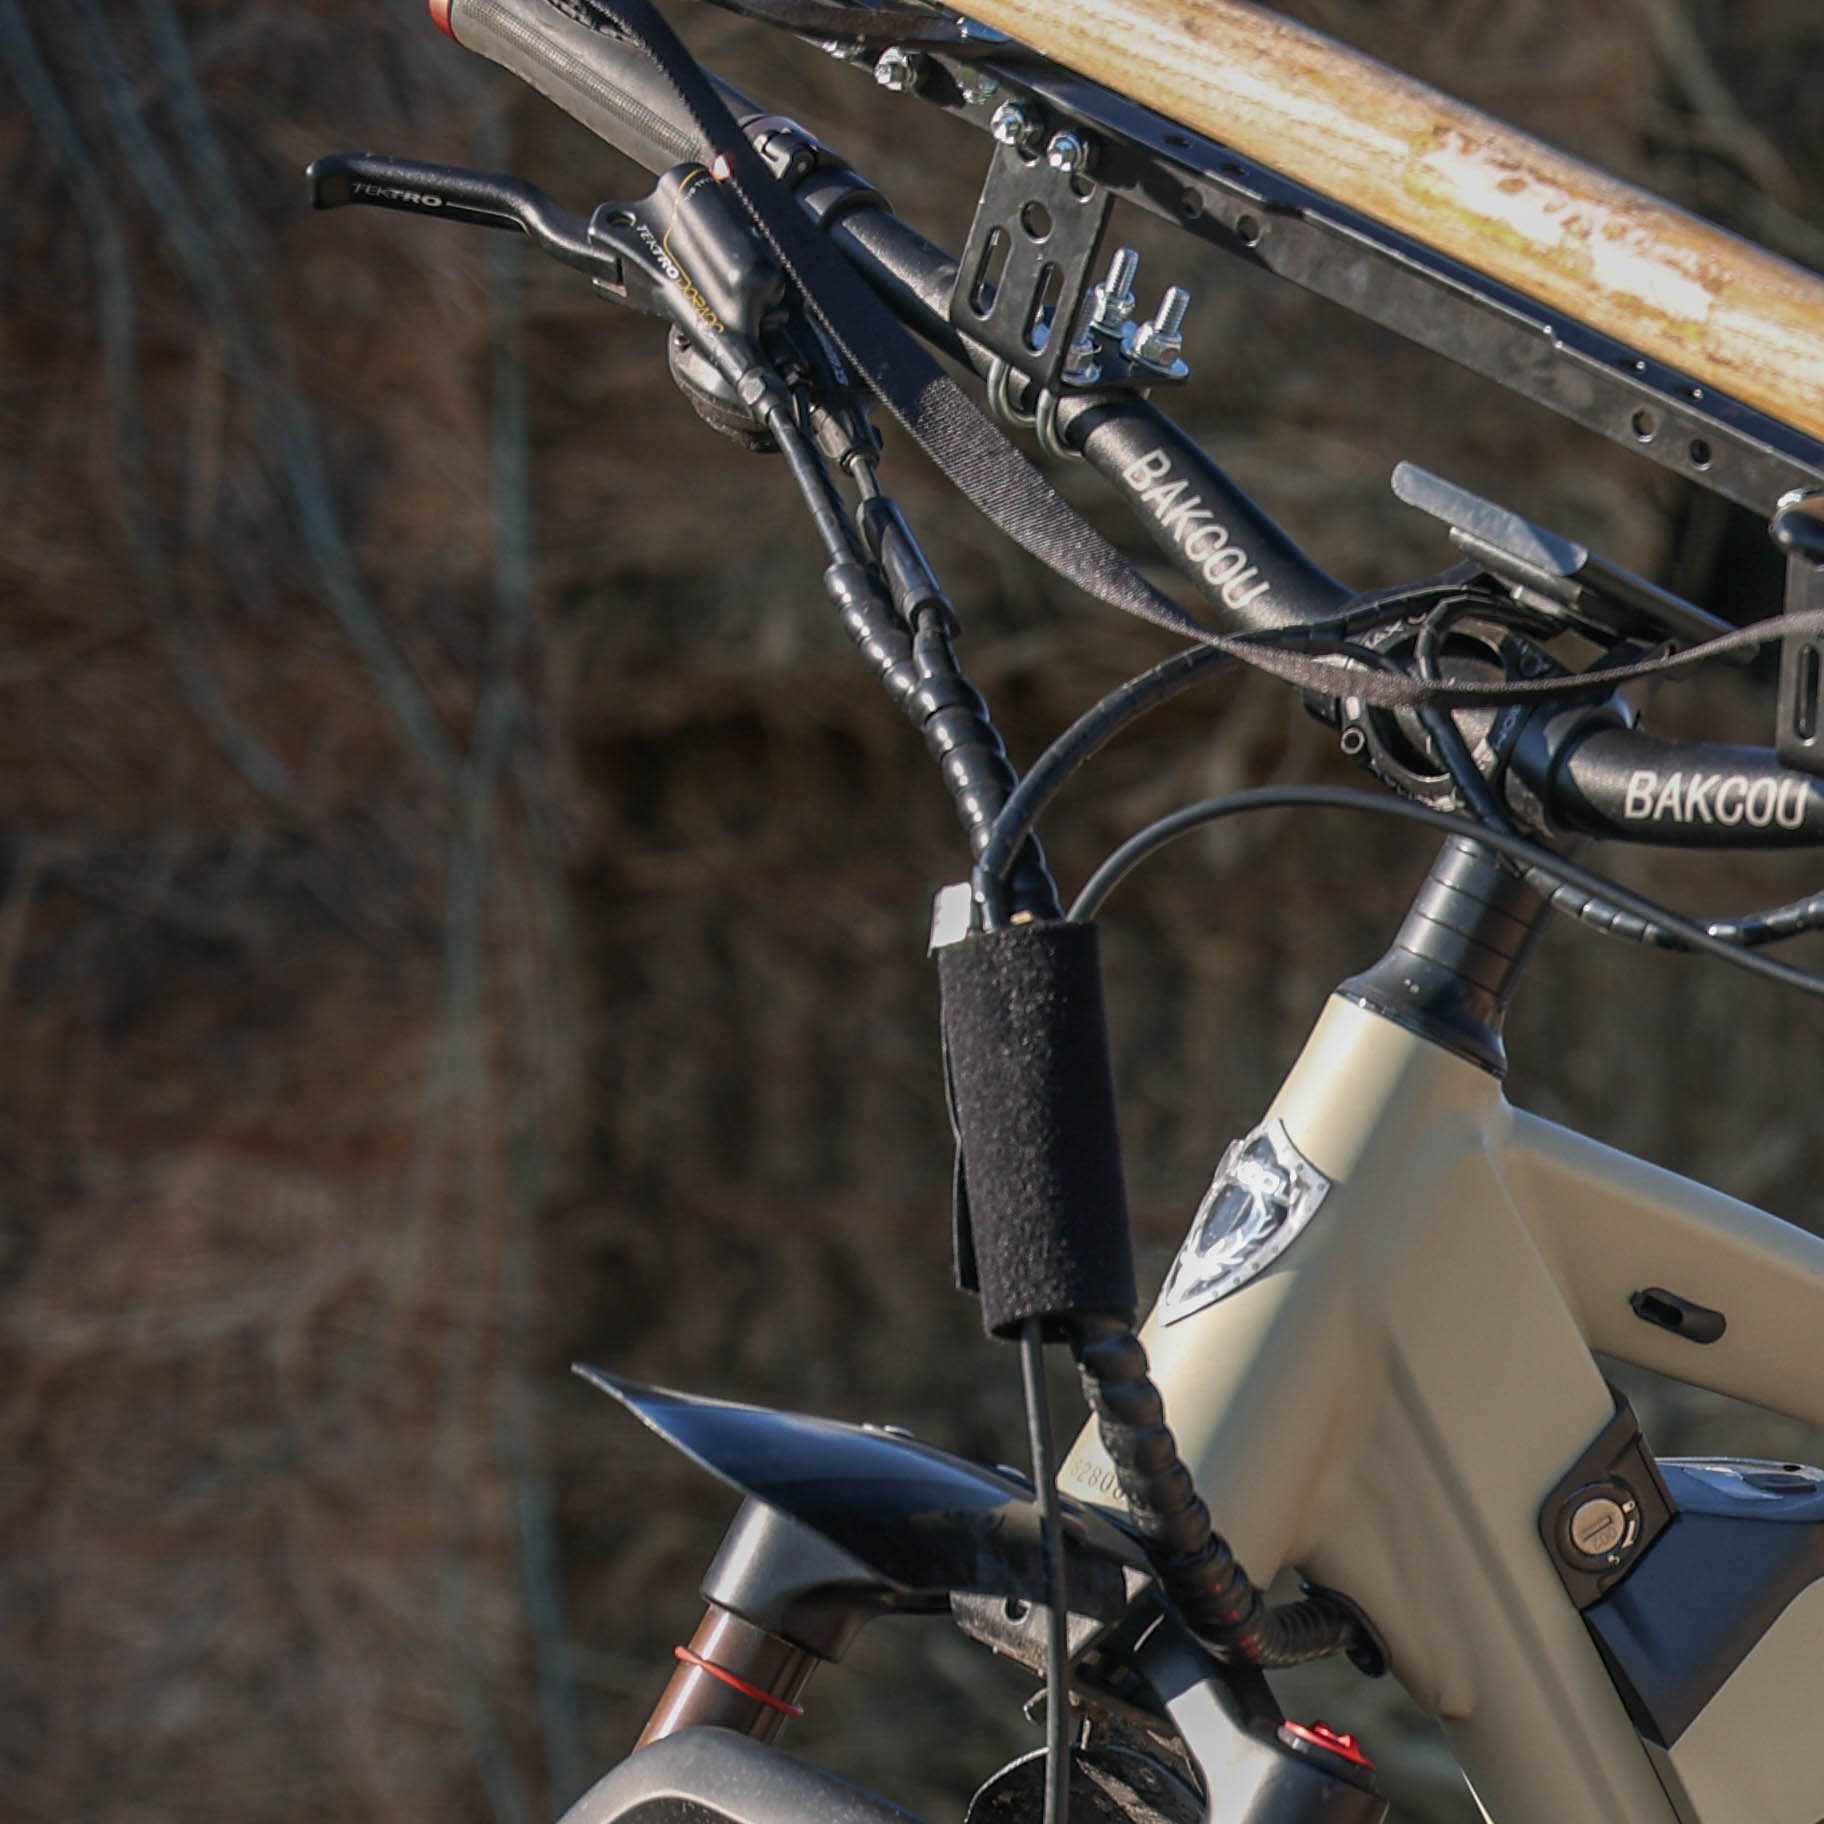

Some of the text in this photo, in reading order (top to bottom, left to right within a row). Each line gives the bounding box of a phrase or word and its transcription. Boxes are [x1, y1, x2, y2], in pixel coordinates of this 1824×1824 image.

[351, 181, 442, 208] TEKTRO
[636, 223, 680, 280] TEKTRO
[1124, 448, 1271, 612] BAKCOU
[1624, 770, 1810, 831] BAKCOU
